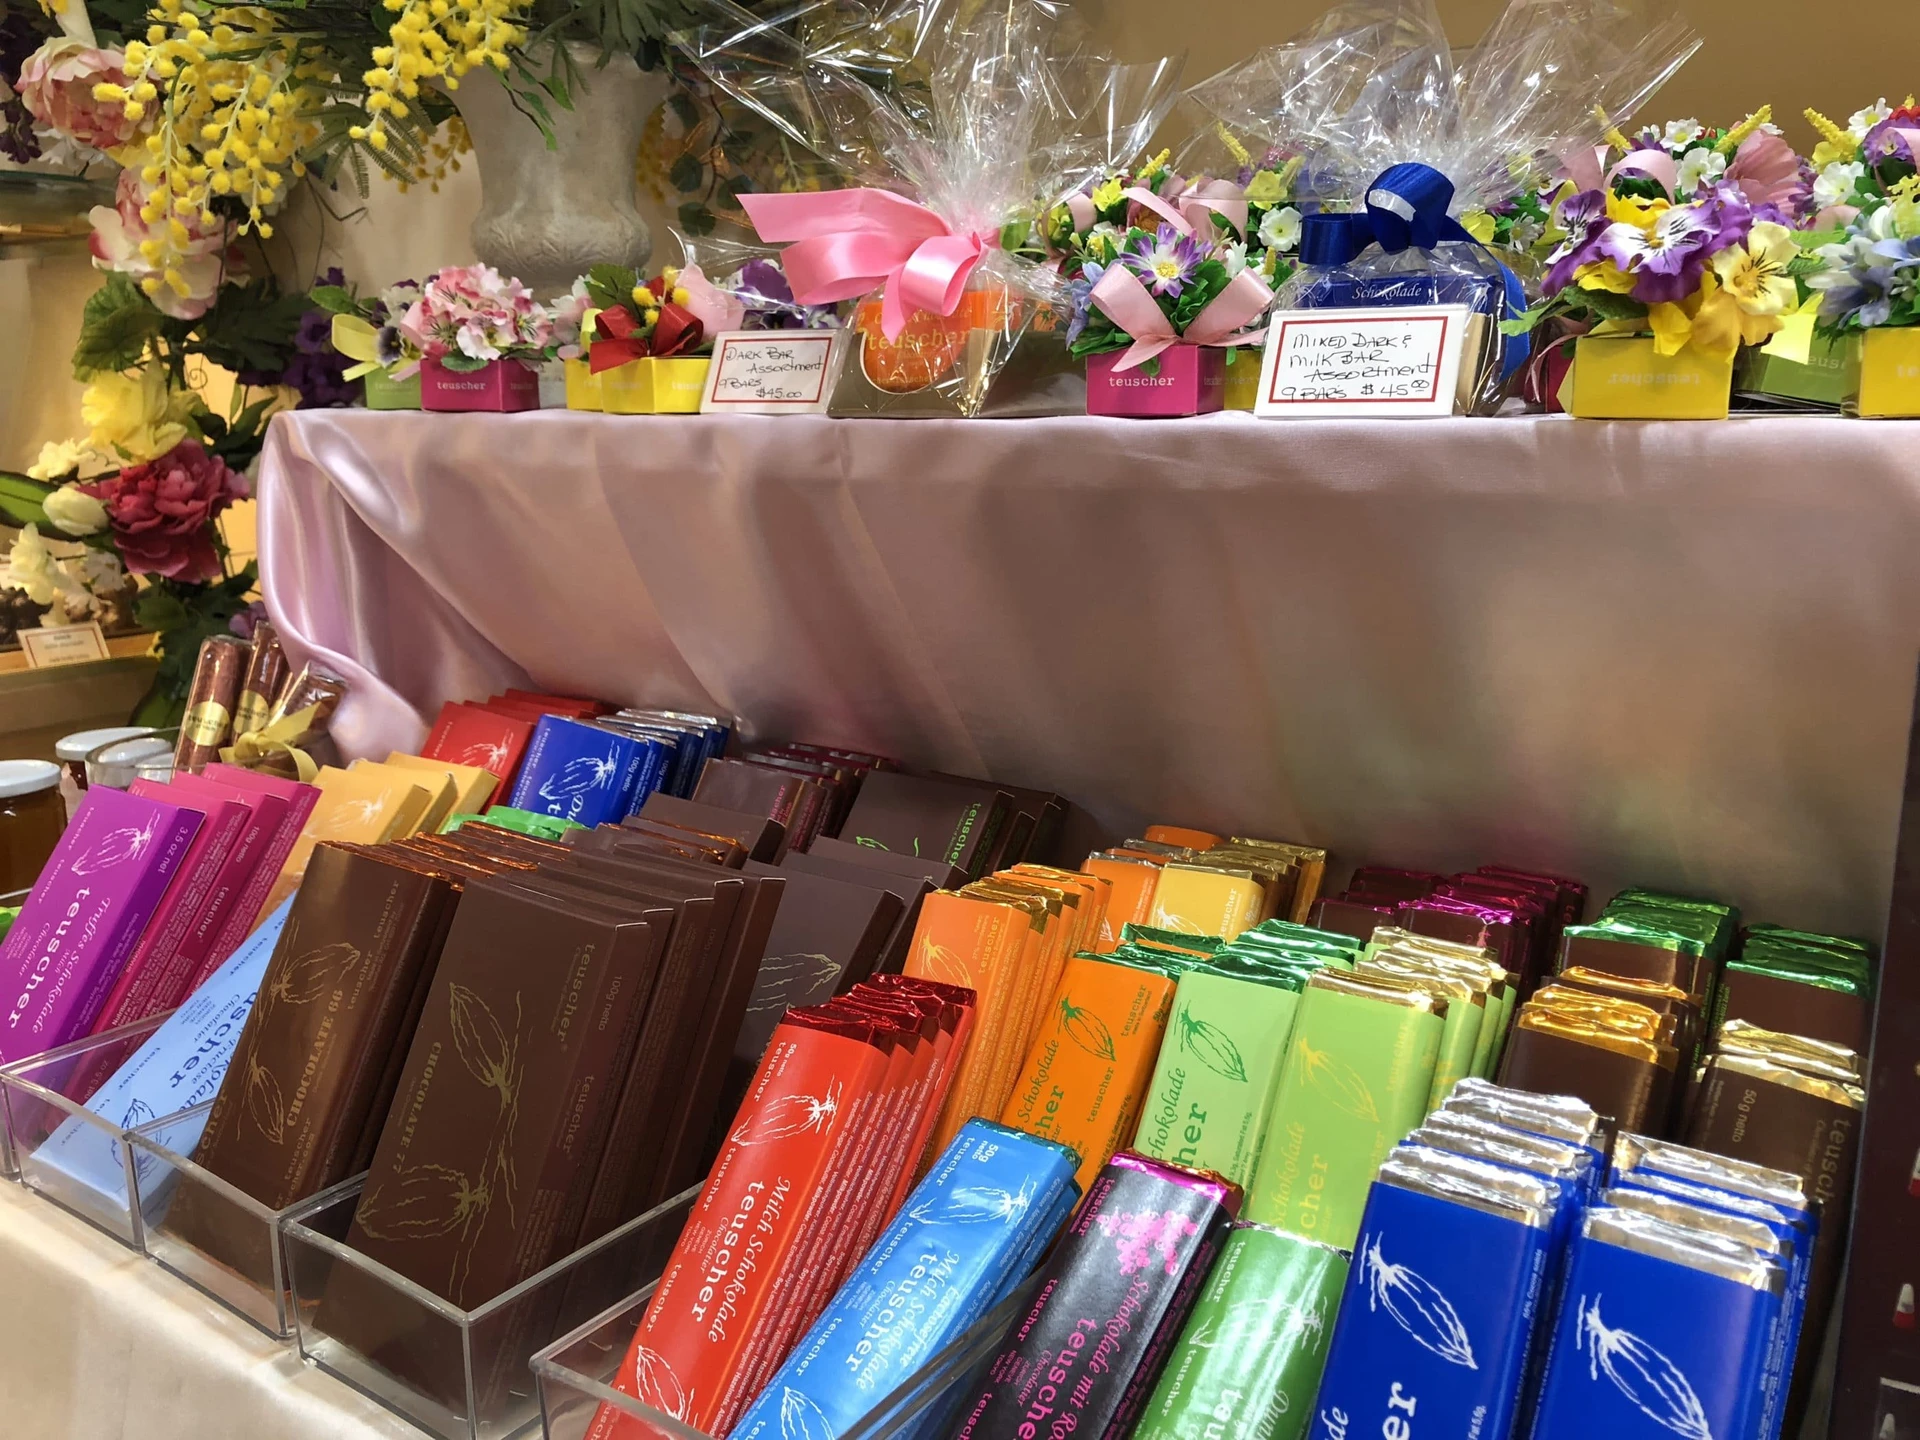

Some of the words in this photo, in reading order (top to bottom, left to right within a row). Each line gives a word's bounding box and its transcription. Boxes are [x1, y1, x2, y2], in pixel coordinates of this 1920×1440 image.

[726, 347, 762, 361] DARK
[766, 346, 794, 360] BAR
[1293, 334, 1347, 349] MIXED
[1352, 332, 1397, 348] DARK
[437, 381, 486, 391] teuscher
[1109, 376, 1175, 387] teuscher
[622, 773, 634, 792] netto
[627, 755, 640, 774] 100g
[166, 842, 180, 857] oz
[173, 826, 190, 844] 3.5
[234, 843, 251, 864] netto
[244, 824, 261, 845] 100g
[947, 799, 982, 870] teuscher
[157, 856, 173, 874] net
[74, 895, 115, 951] Truffes
[194, 885, 231, 939] teuscher
[0, 884, 97, 1030] teuscher
[14, 921, 54, 978] Chocolatier
[228, 933, 268, 981] teuscher
[343, 950, 378, 1011] teuscher
[369, 879, 404, 940] teuscher
[977, 916, 1000, 975] teuscher
[26, 950, 85, 1035] Schokolade
[555, 941, 598, 1043] teuscher
[605, 973, 623, 1002] 100g
[192, 989, 241, 1049] Chocolatier
[597, 1003, 614, 1032] netto
[117, 1042, 162, 1095] teuscher
[190, 1032, 238, 1090] Fructose
[277, 1014, 342, 1128] CHOCOLATE
[326, 988, 346, 1014] 66
[752, 1040, 789, 1103] teuscher
[776, 1058, 789, 1078] netto
[784, 1042, 798, 1060] 50g
[1011, 1037, 1065, 1124] Schokolade
[1084, 1066, 1118, 1124] teuscher
[1118, 984, 1150, 1038] teuscher
[399, 1040, 443, 1149] CHOCOLATE
[560, 1073, 595, 1155] teuscher
[1139, 1065, 1194, 1161] chokolade
[191, 1088, 234, 1165] scher
[279, 1116, 317, 1182] teuscher
[971, 1138, 988, 1161] netto
[977, 1140, 999, 1166] 50g
[1730, 1113, 1750, 1144] netto
[390, 1152, 406, 1174] 77
[700, 1146, 739, 1213] teuscher
[935, 1132, 976, 1190] teuscher
[754, 1175, 795, 1236] Milch
[1076, 1175, 1116, 1240] teuscher
[688, 1176, 768, 1325] teuscher
[696, 1215, 732, 1275] Chocolatier
[869, 1219, 914, 1276] teuscher
[1212, 1239, 1246, 1304] teuscher
[644, 1261, 684, 1334] teuscher
[703, 1232, 768, 1345] Schokolade
[856, 1278, 898, 1330] Chocolatier
[916, 1248, 966, 1305] Milch
[841, 1248, 943, 1374] teuscher
[1015, 1275, 1059, 1343] teuscher
[1082, 1271, 1155, 1378] Schokolade
[794, 1315, 843, 1378] teuscher
[850, 1297, 929, 1393] Schokolade
[1013, 1312, 1100, 1440] teusche
[1014, 1348, 1054, 1408] Chocolatier
[1068, 1375, 1101, 1412] mit
[1160, 1347, 1197, 1418] teuscher
